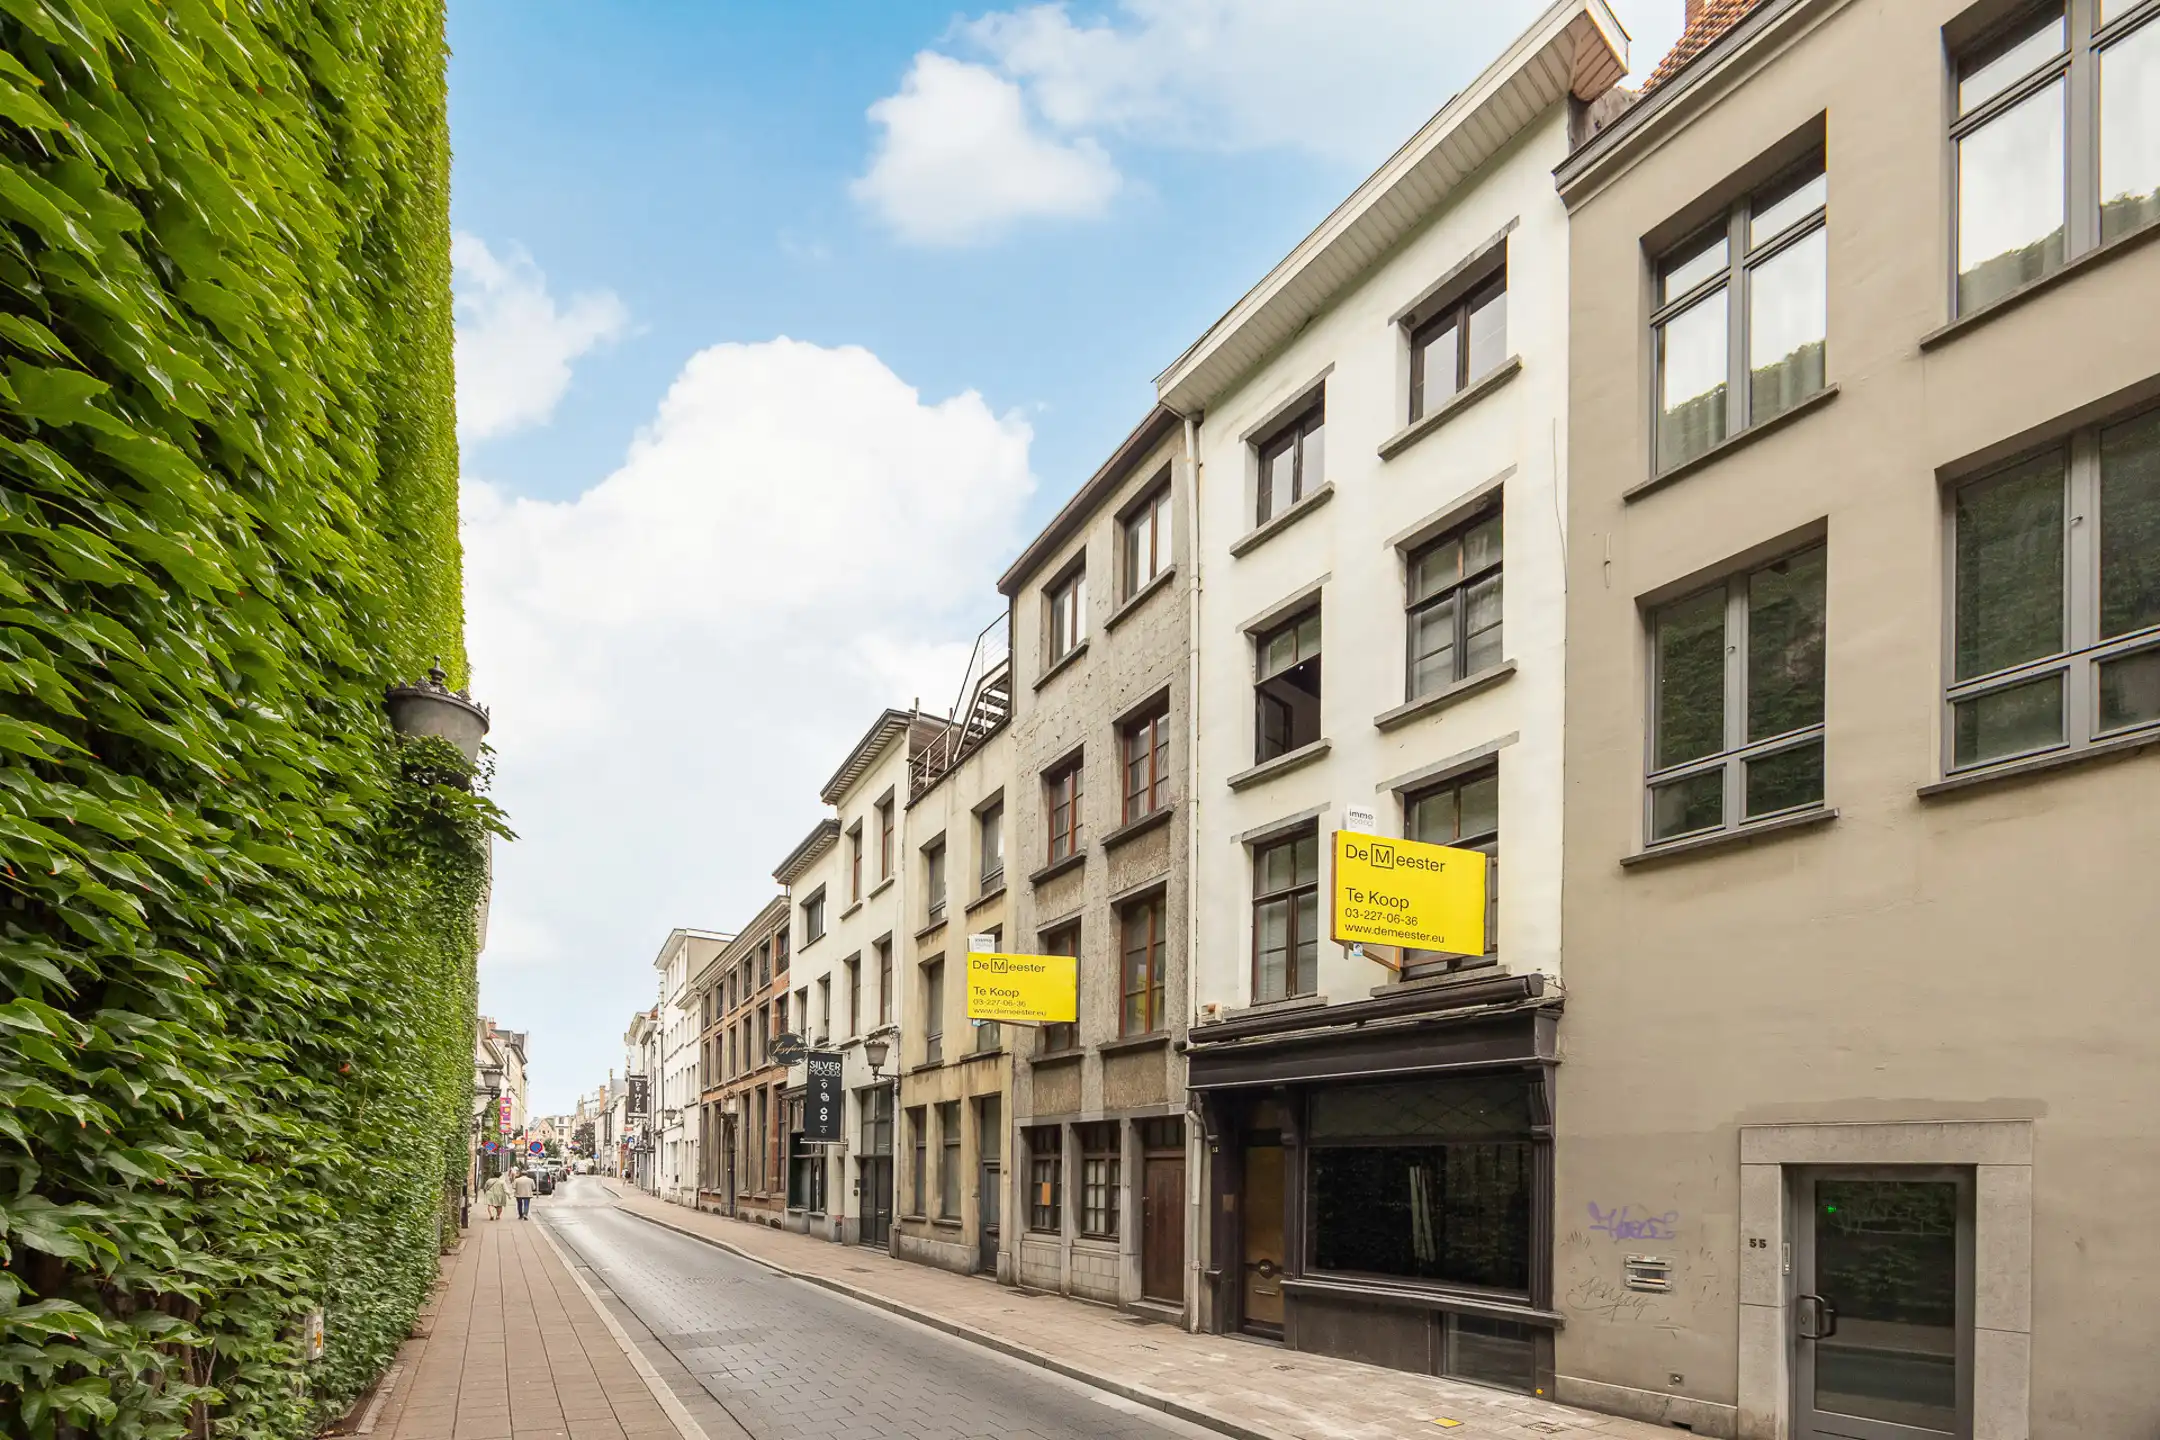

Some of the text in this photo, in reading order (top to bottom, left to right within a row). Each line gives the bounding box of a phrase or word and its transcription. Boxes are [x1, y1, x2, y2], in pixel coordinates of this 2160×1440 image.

[1349, 808, 1374, 820] immo
[1345, 887, 1410, 911] Te Koop
[1344, 908, 1418, 926] 03-227-06-36
[1344, 924, 1445, 944] www.demeester.eu
[973, 986, 1020, 998] Te Koop
[809, 1060, 841, 1071] SILVER
[809, 1068, 841, 1077] MOODS
[1749, 1238, 1767, 1249] 55
